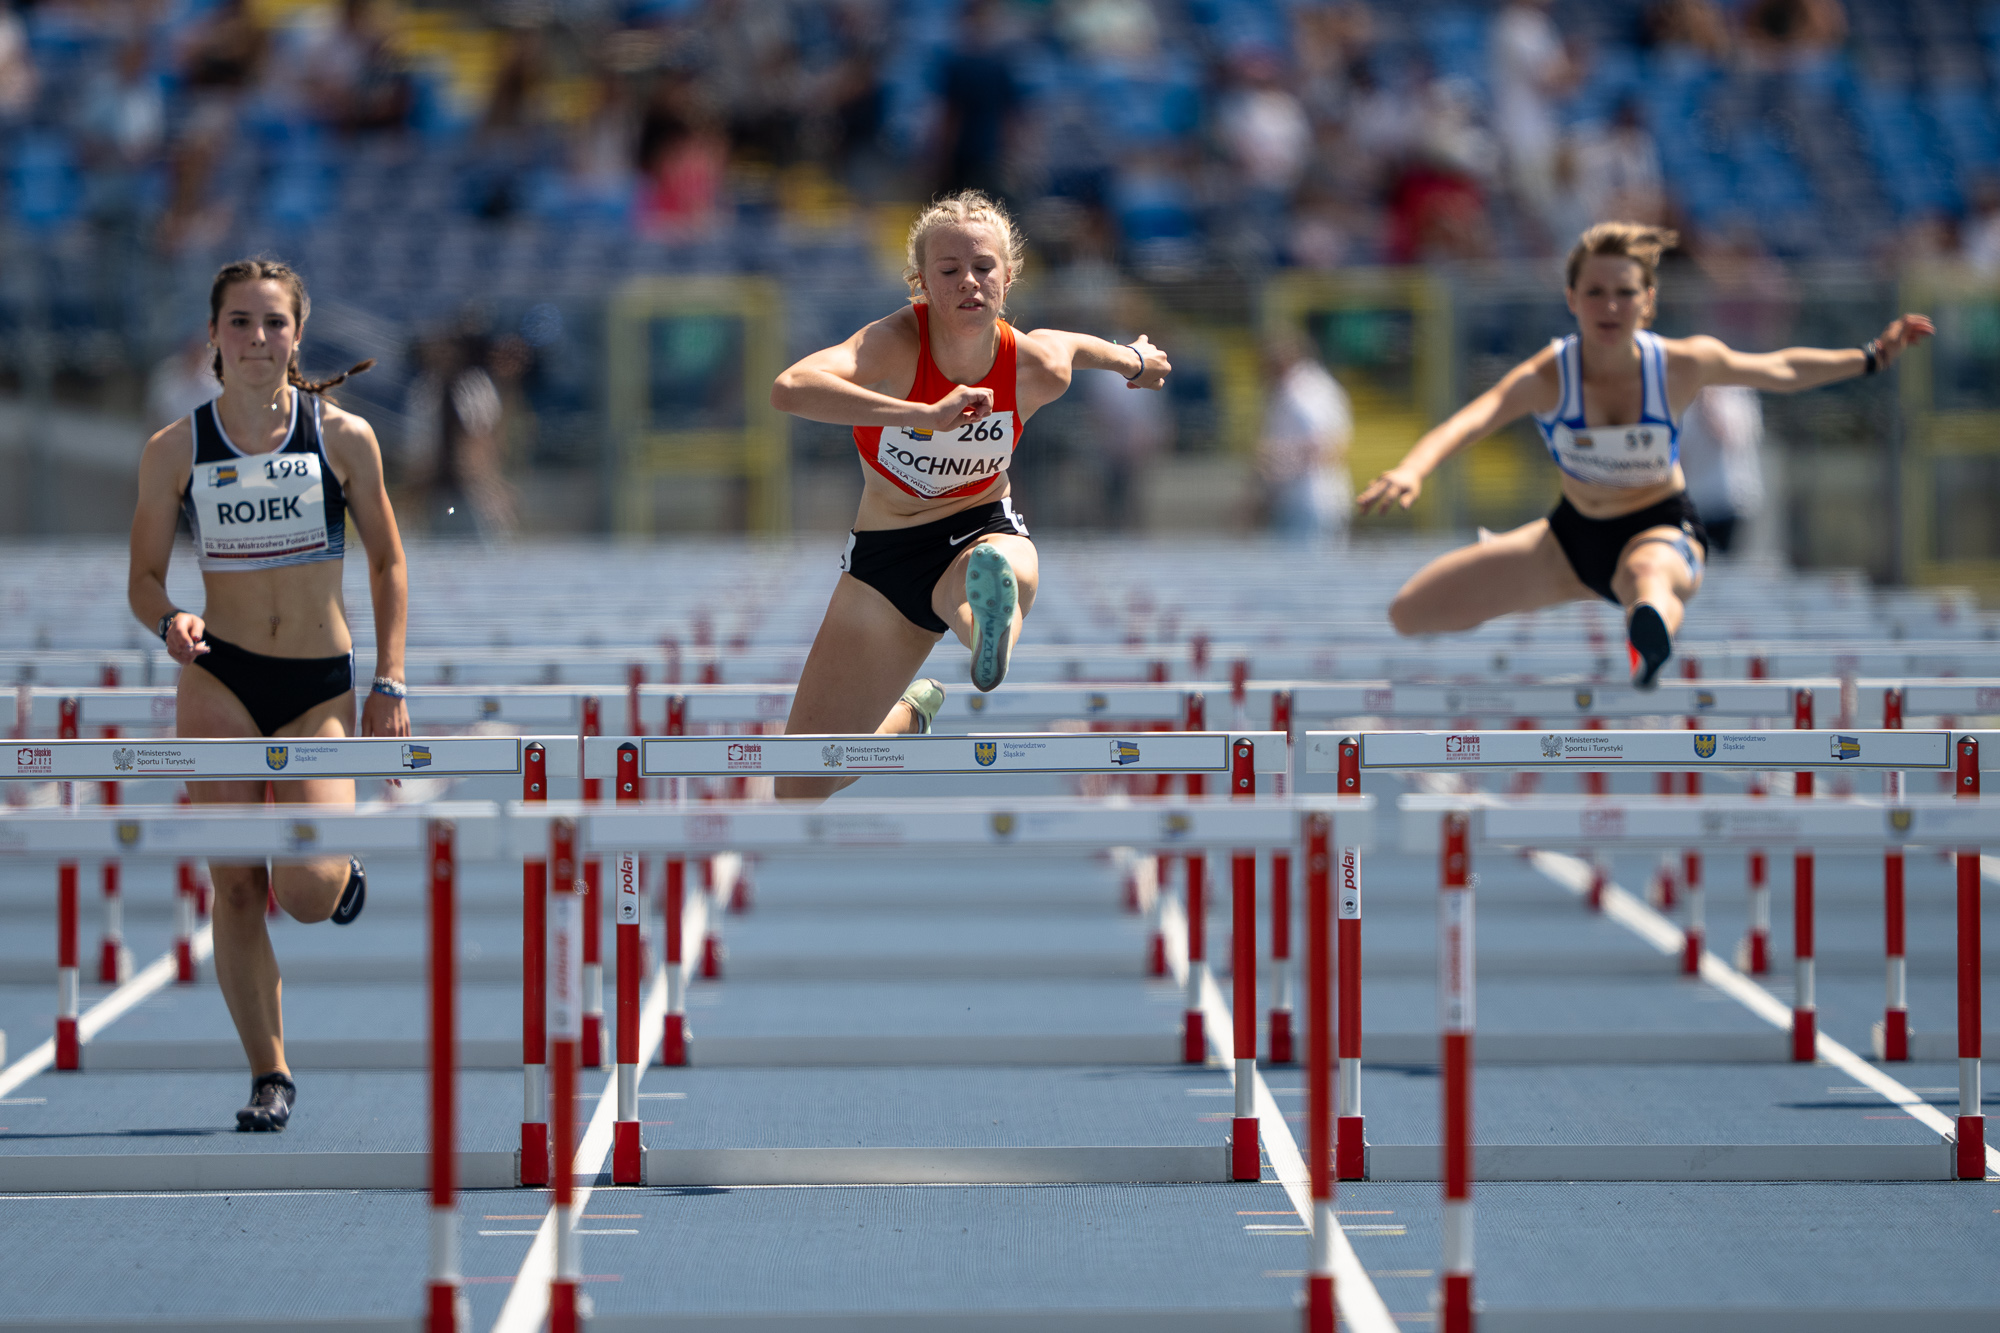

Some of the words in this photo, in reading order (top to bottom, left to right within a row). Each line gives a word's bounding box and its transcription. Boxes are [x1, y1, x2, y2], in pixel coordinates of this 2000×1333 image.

[957, 419, 1004, 442] 266
[885, 442, 1004, 476] ZOCHNIAK
[264, 459, 309, 480] 198
[217, 495, 303, 525] ROJEK
[1722, 742, 1745, 750] Śląskie
[136, 758, 160, 766] Sportu
[165, 758, 196, 766] Turystyki
[294, 754, 318, 762] Śląskie
[874, 754, 904, 762] Turystyki
